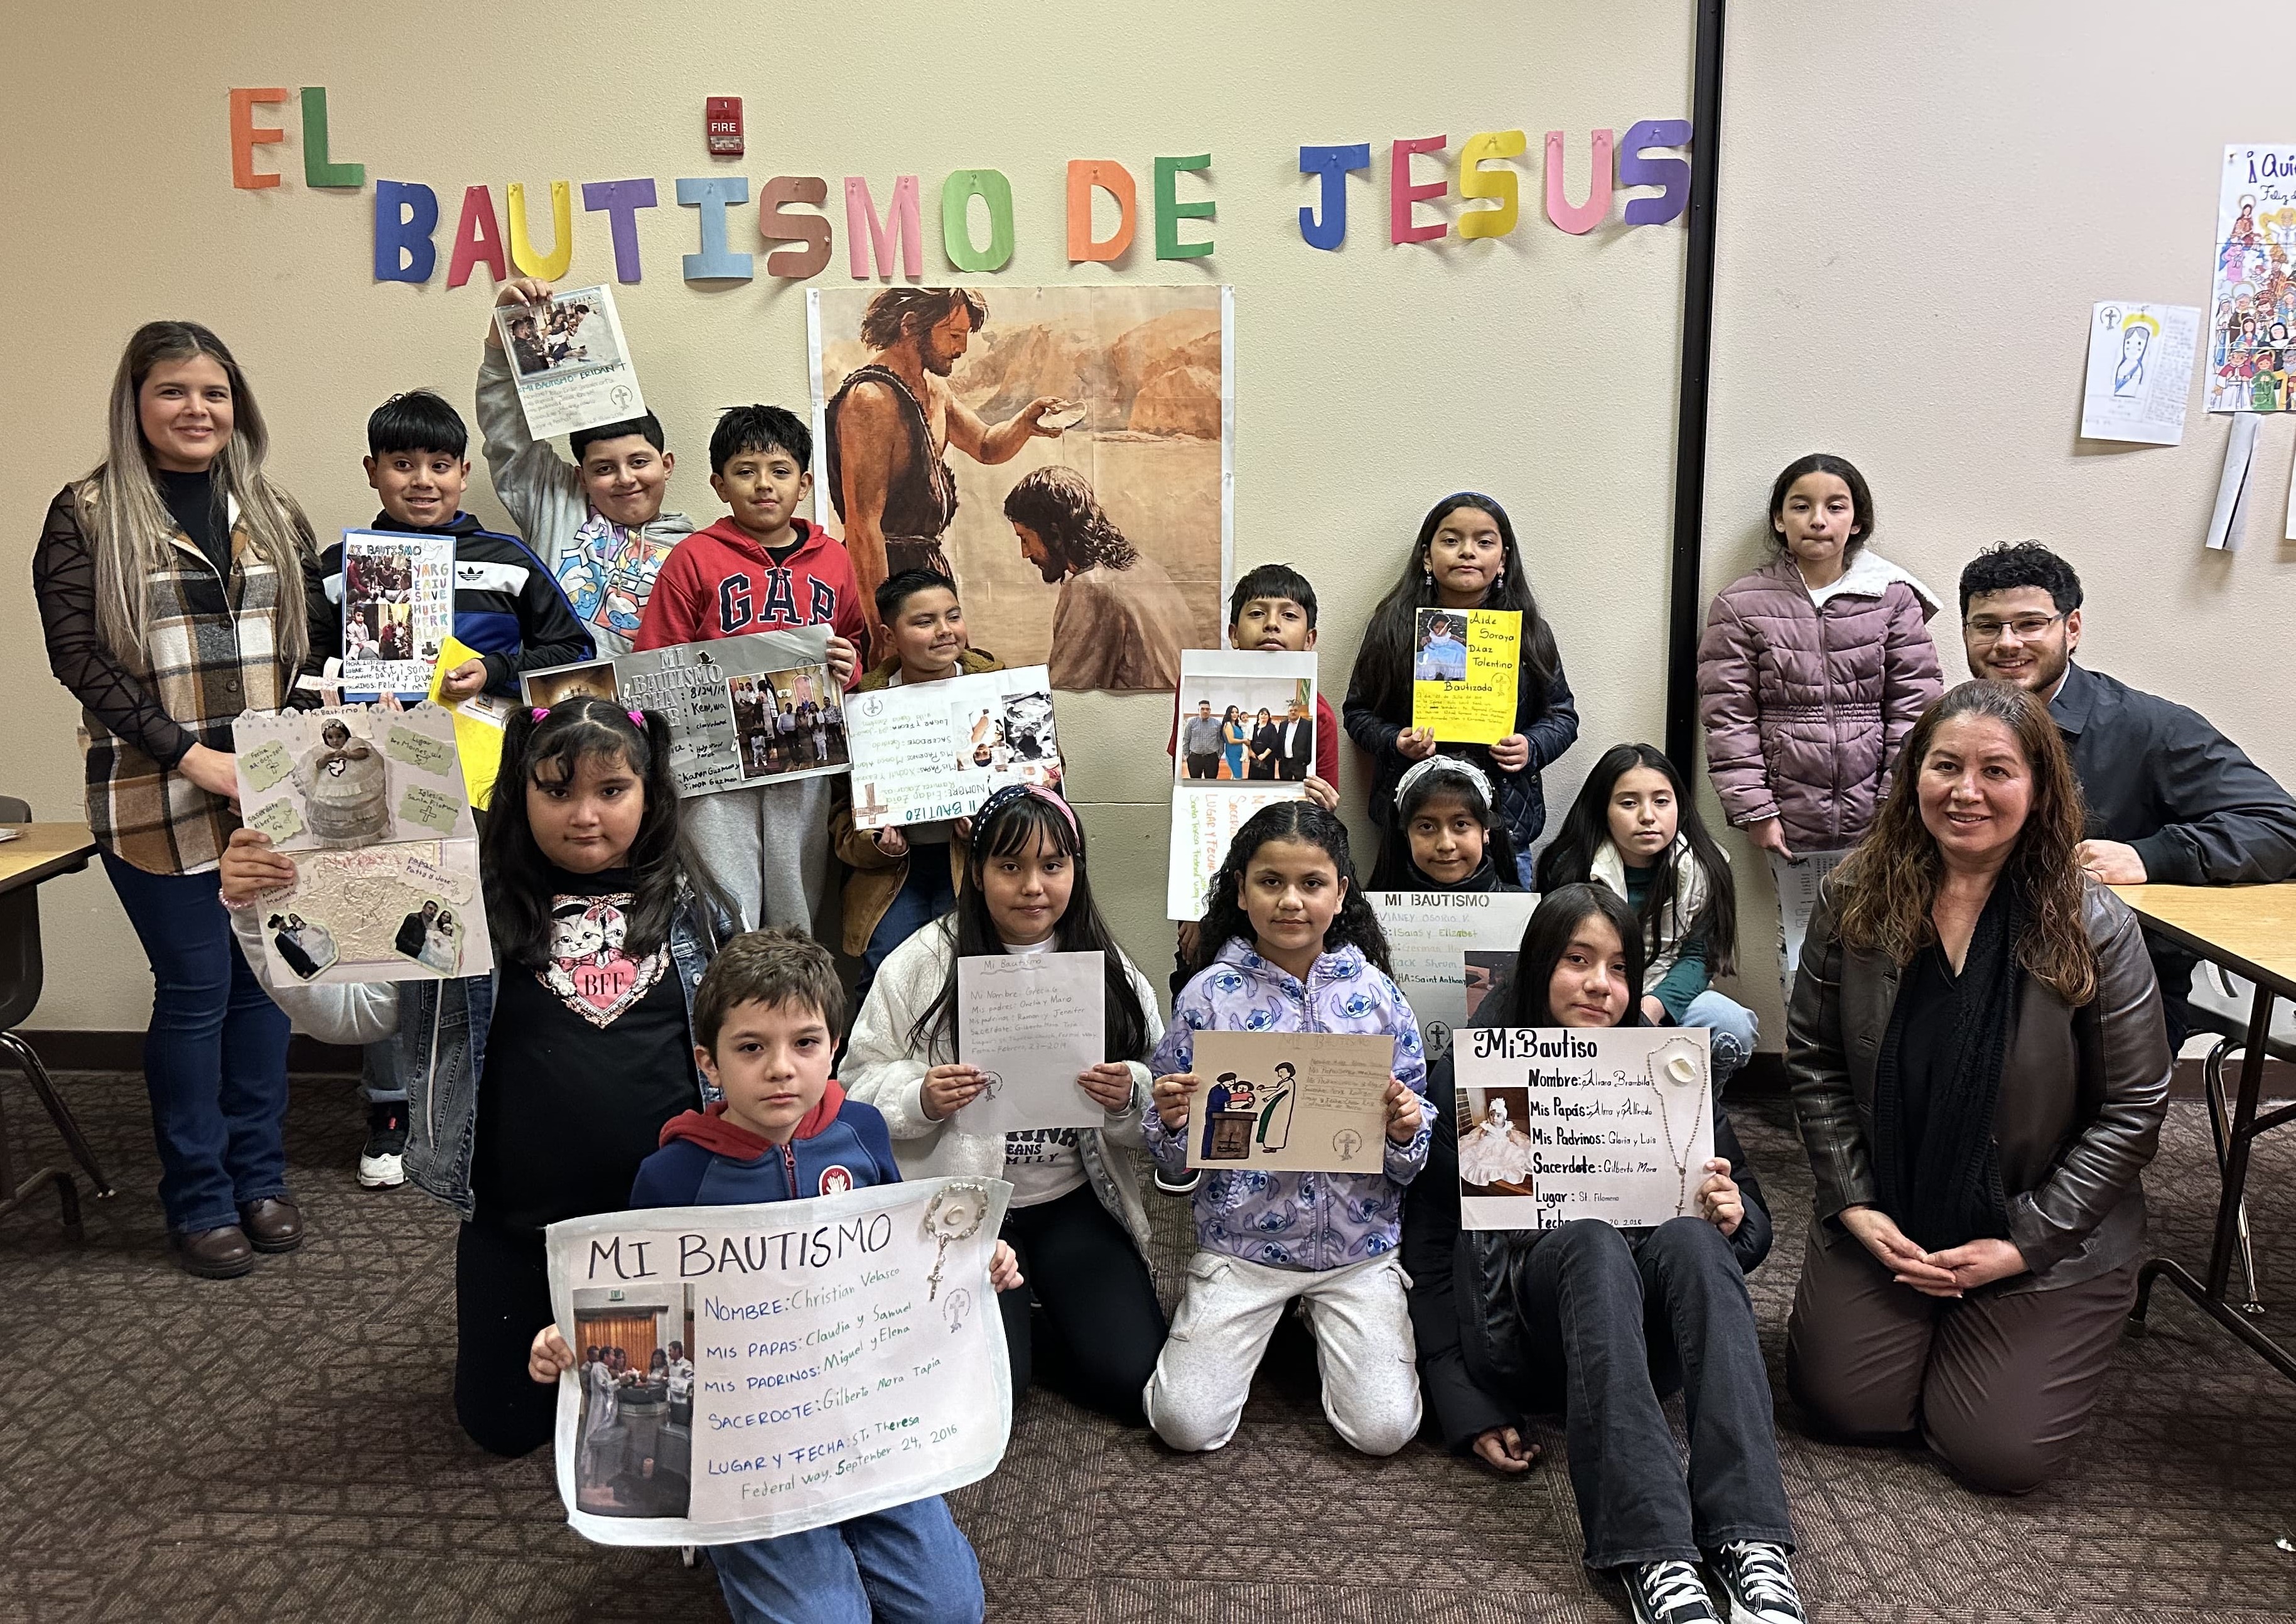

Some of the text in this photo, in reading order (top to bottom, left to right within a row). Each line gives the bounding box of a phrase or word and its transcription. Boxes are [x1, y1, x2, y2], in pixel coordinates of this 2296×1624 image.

[711, 122, 736, 133] FIRE
[230, 86, 1692, 288] EL BAUTISMO DE JESUS
[580, 364, 615, 380] ERIDAN
[367, 544, 422, 556] BAUTISMO
[719, 566, 836, 634] GAP
[1470, 611, 1497, 625] Aide
[1479, 628, 1515, 642] Soraya
[660, 647, 685, 670] MI
[1472, 657, 1513, 669] Tolentino
[632, 664, 723, 695] BAUTISMO
[1443, 681, 1492, 691] Bautizada
[906, 801, 962, 821] BAUTIZO
[1385, 894, 1490, 907] MI BAUTISMO
[984, 960, 994, 970] Mi
[585, 972, 625, 996] BFF
[1415, 975, 1437, 983] Saint
[1050, 995, 1072, 1004] Mario
[1530, 1101, 1550, 1117] Mis
[1532, 1127, 1552, 1145] Mis
[1634, 1139, 1638, 1147] y
[1006, 1144, 1042, 1155] EANS
[1603, 1159, 1633, 1173] Gilberto
[1636, 1161, 1657, 1173] Mora
[589, 1213, 892, 1279] MI BAUTISMO
[791, 1285, 855, 1310] Christian
[860, 1267, 900, 1287] Velasco
[707, 1347, 737, 1359] MIS
[806, 1321, 851, 1346] Claudia
[857, 1315, 864, 1329] y
[873, 1302, 912, 1322] Samuel
[704, 1380, 735, 1393] MIS
[823, 1341, 864, 1372] Miguel
[871, 1336, 878, 1351] y
[879, 1324, 910, 1342] Elena
[822, 1386, 869, 1410] Gilberto
[877, 1375, 905, 1392] Mora
[912, 1357, 942, 1377] Tapia
[708, 1459, 767, 1475] LUGAR
[875, 1415, 920, 1434] Theresa
[741, 1474, 795, 1500] Federal
[835, 1446, 892, 1476] September
[930, 1424, 959, 1444] 2016
